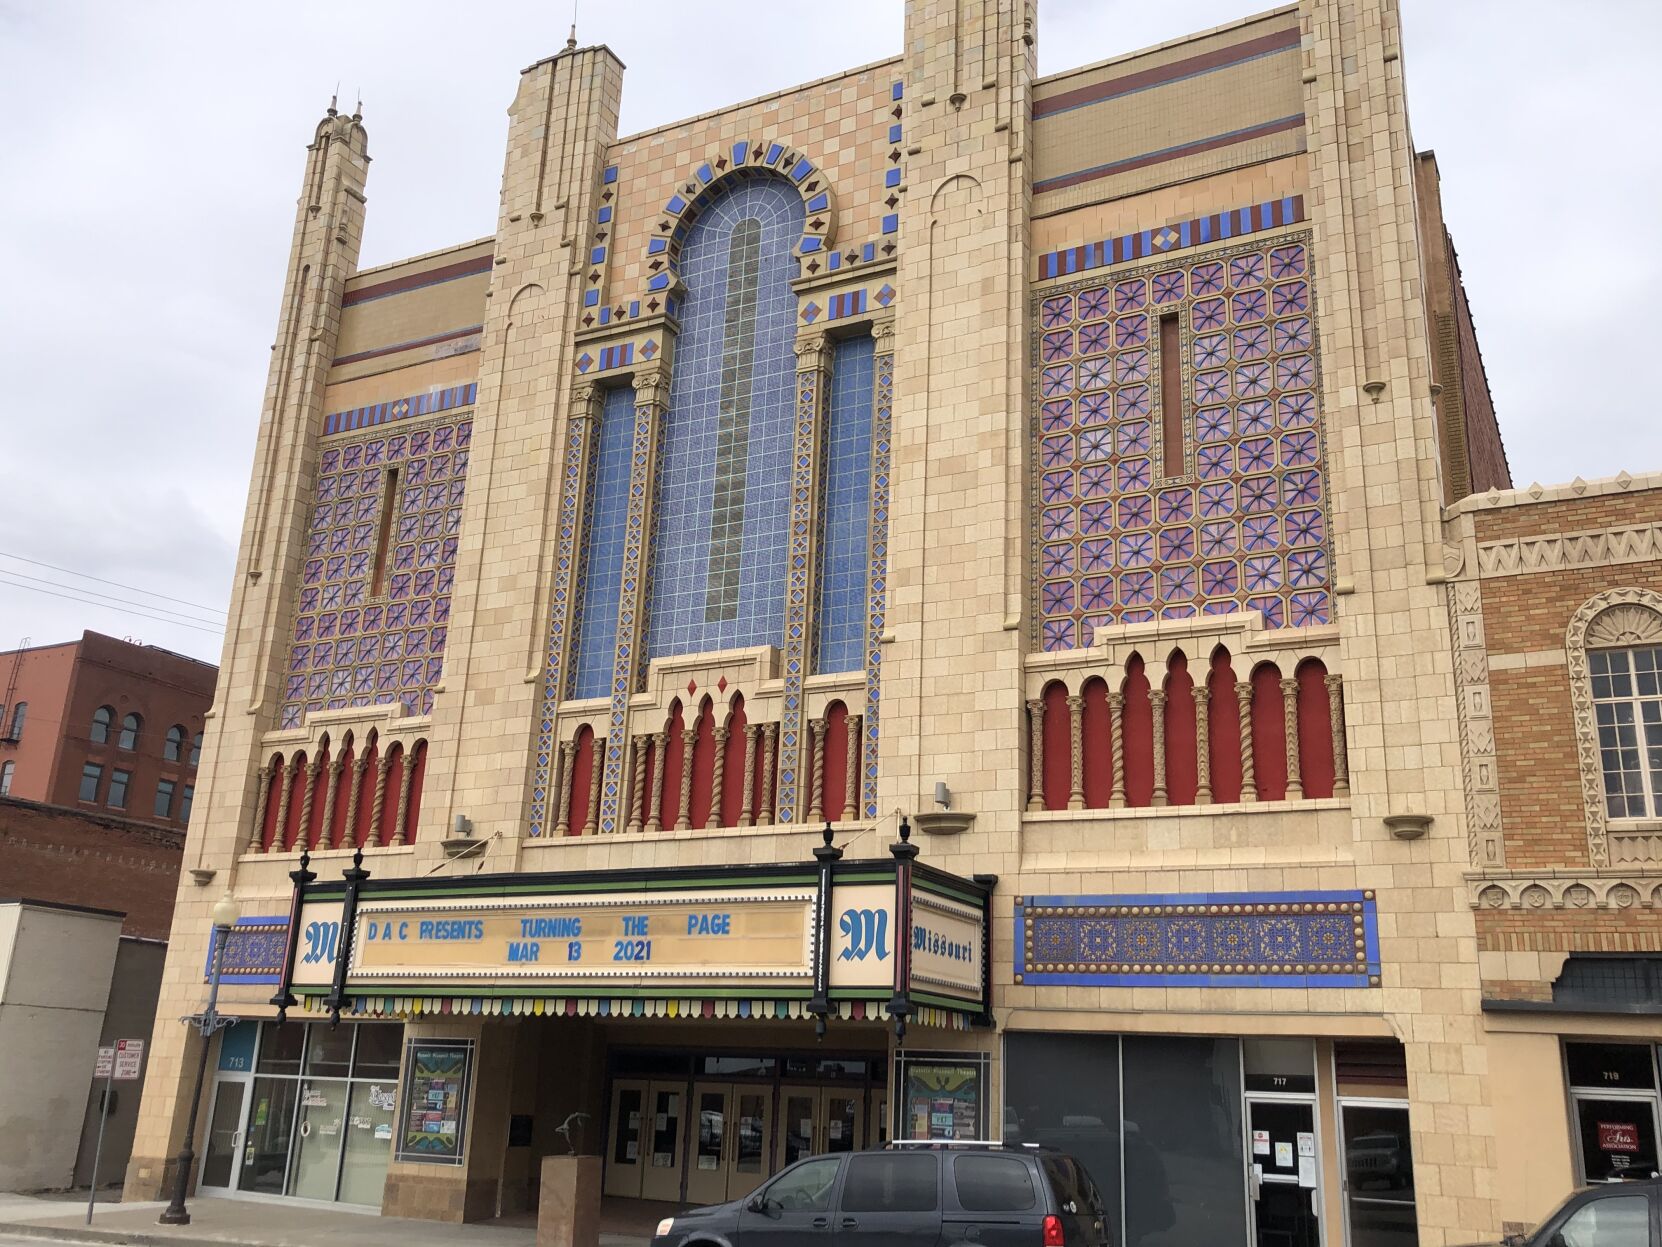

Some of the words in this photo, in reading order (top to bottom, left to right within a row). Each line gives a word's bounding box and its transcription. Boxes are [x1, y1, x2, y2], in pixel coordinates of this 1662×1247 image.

[419, 920, 484, 940] PRESENTS
[521, 917, 582, 938] TURNING
[623, 915, 648, 937] THE
[687, 914, 730, 936] PAGE
[508, 941, 540, 961] MAR
[568, 940, 582, 961] 13
[613, 940, 651, 961] 2021
[913, 926, 972, 963] Missouri
[230, 1056, 244, 1068] 713
[1273, 1078, 1287, 1086] 717
[1603, 1071, 1619, 1080] 719
